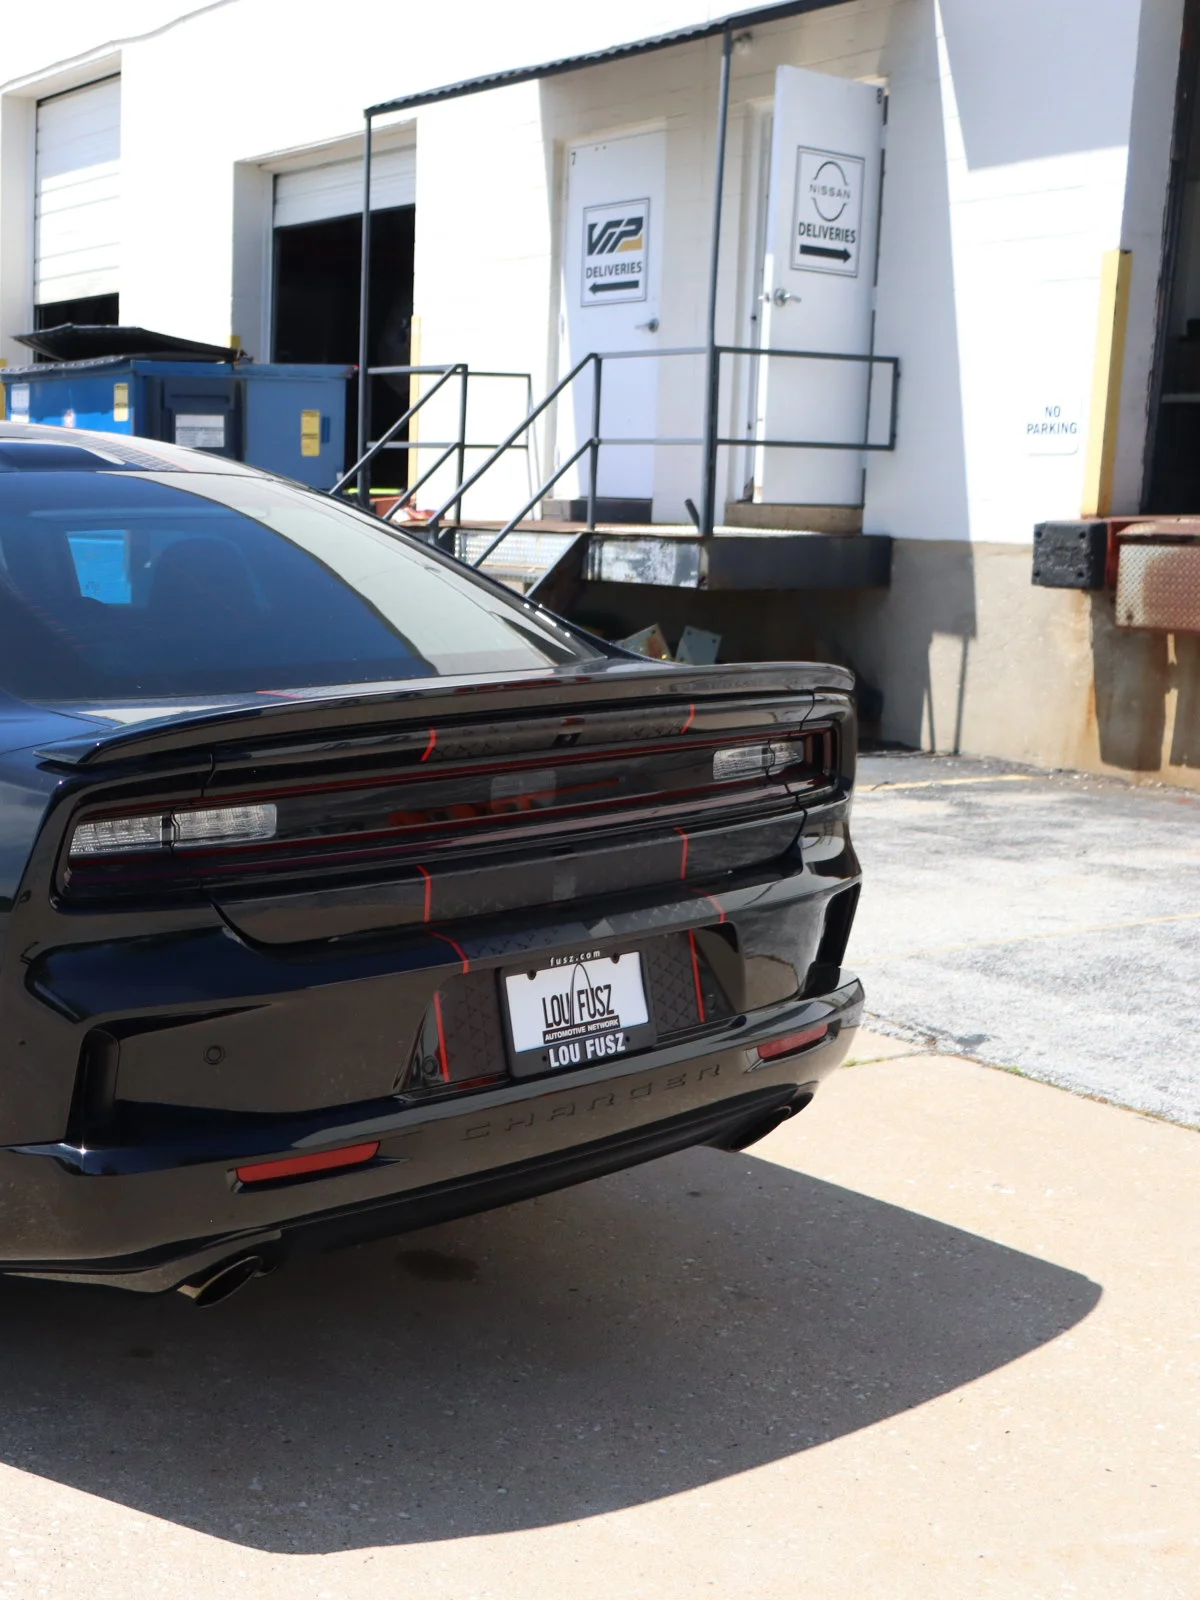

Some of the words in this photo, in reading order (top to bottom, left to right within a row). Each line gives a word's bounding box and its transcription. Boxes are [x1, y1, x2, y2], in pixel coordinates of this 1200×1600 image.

[809, 184, 851, 199] NISSAN
[587, 216, 644, 256] VIP
[798, 222, 856, 244] DELIVERIES
[585, 261, 643, 279] DELIVERIES
[1045, 405, 1061, 418] NO
[1027, 422, 1078, 434] PARKING
[550, 950, 601, 967] fusz.com
[542, 992, 571, 1029] LOU
[577, 984, 615, 1022] FUSZ
[545, 1025, 587, 1041] AUTOMOTIVE
[587, 1018, 619, 1034] NETWORK
[548, 1042, 581, 1068] LOU
[585, 1032, 626, 1059] FUSZ
[461, 1064, 721, 1141] CHARGER
